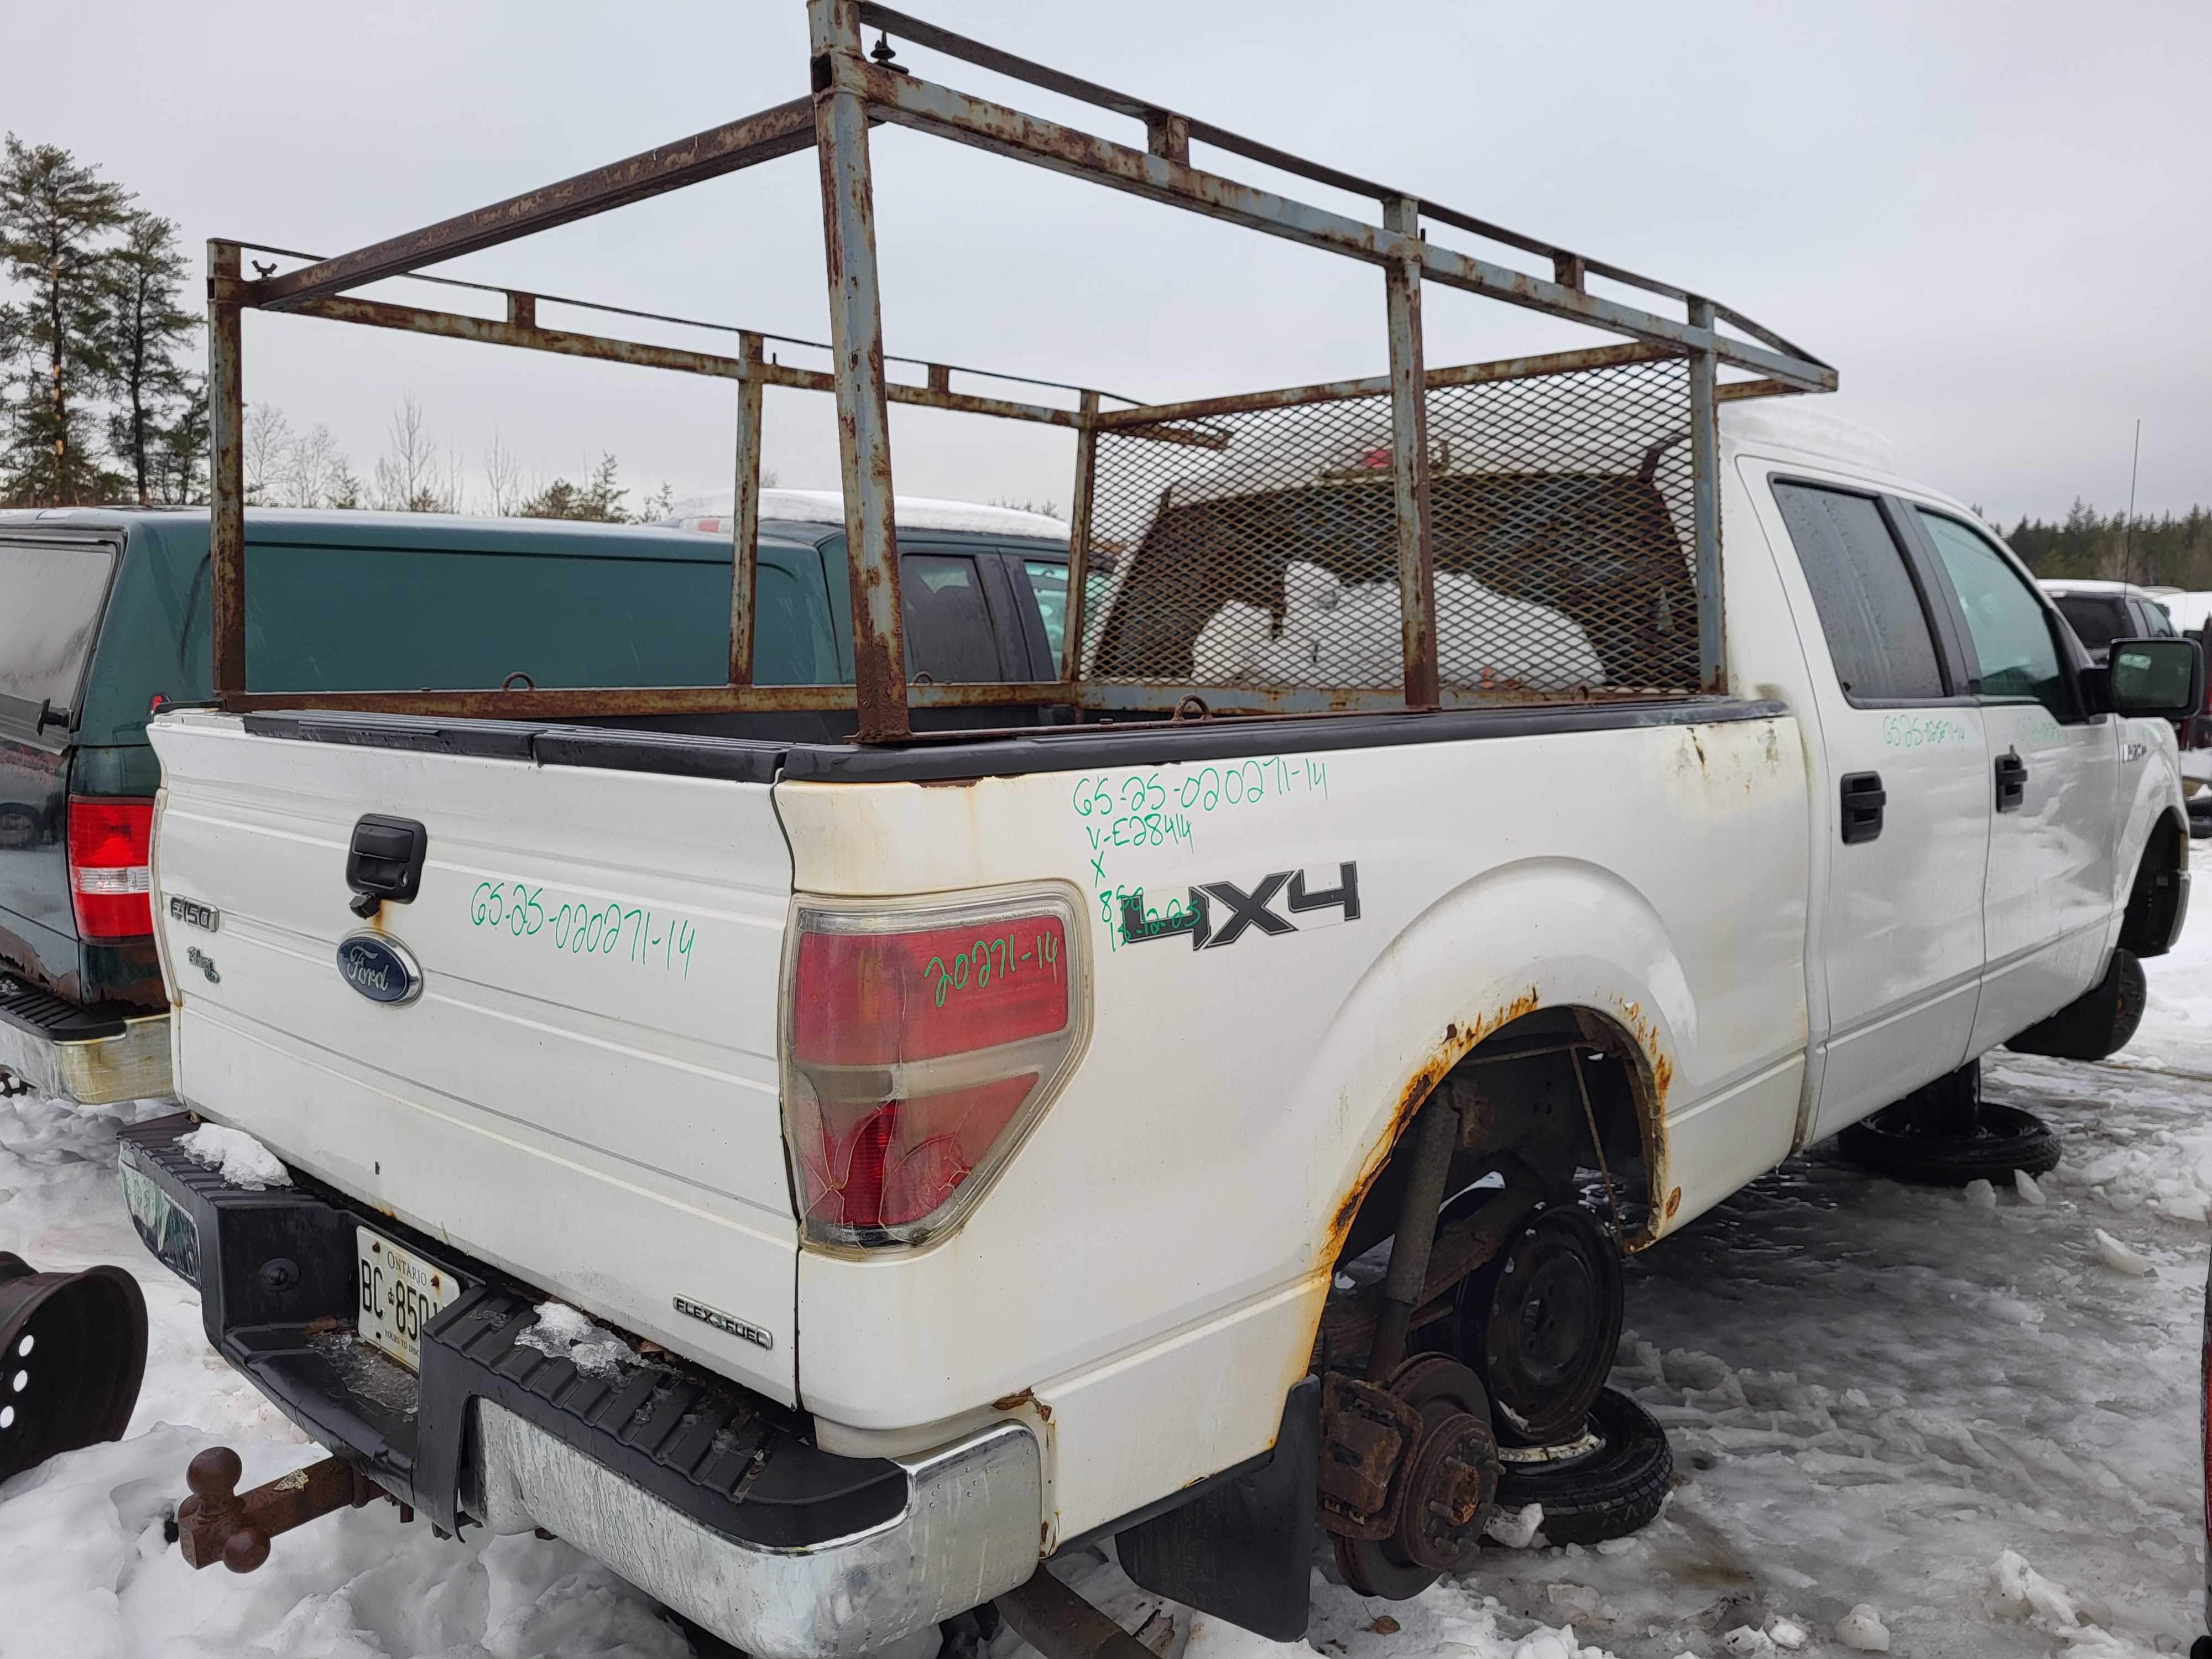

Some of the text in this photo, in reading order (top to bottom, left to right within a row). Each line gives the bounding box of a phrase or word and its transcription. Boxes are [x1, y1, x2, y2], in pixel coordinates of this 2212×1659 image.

[346, 945, 389, 991] Ford
[387, 1251, 427, 1286] ONTARIO
[361, 1258, 446, 1342] BC 850
[676, 1298, 766, 1347] FLEX FUEL
[400, 1339, 408, 1350] TO
[409, 1344, 420, 1358] DISC
